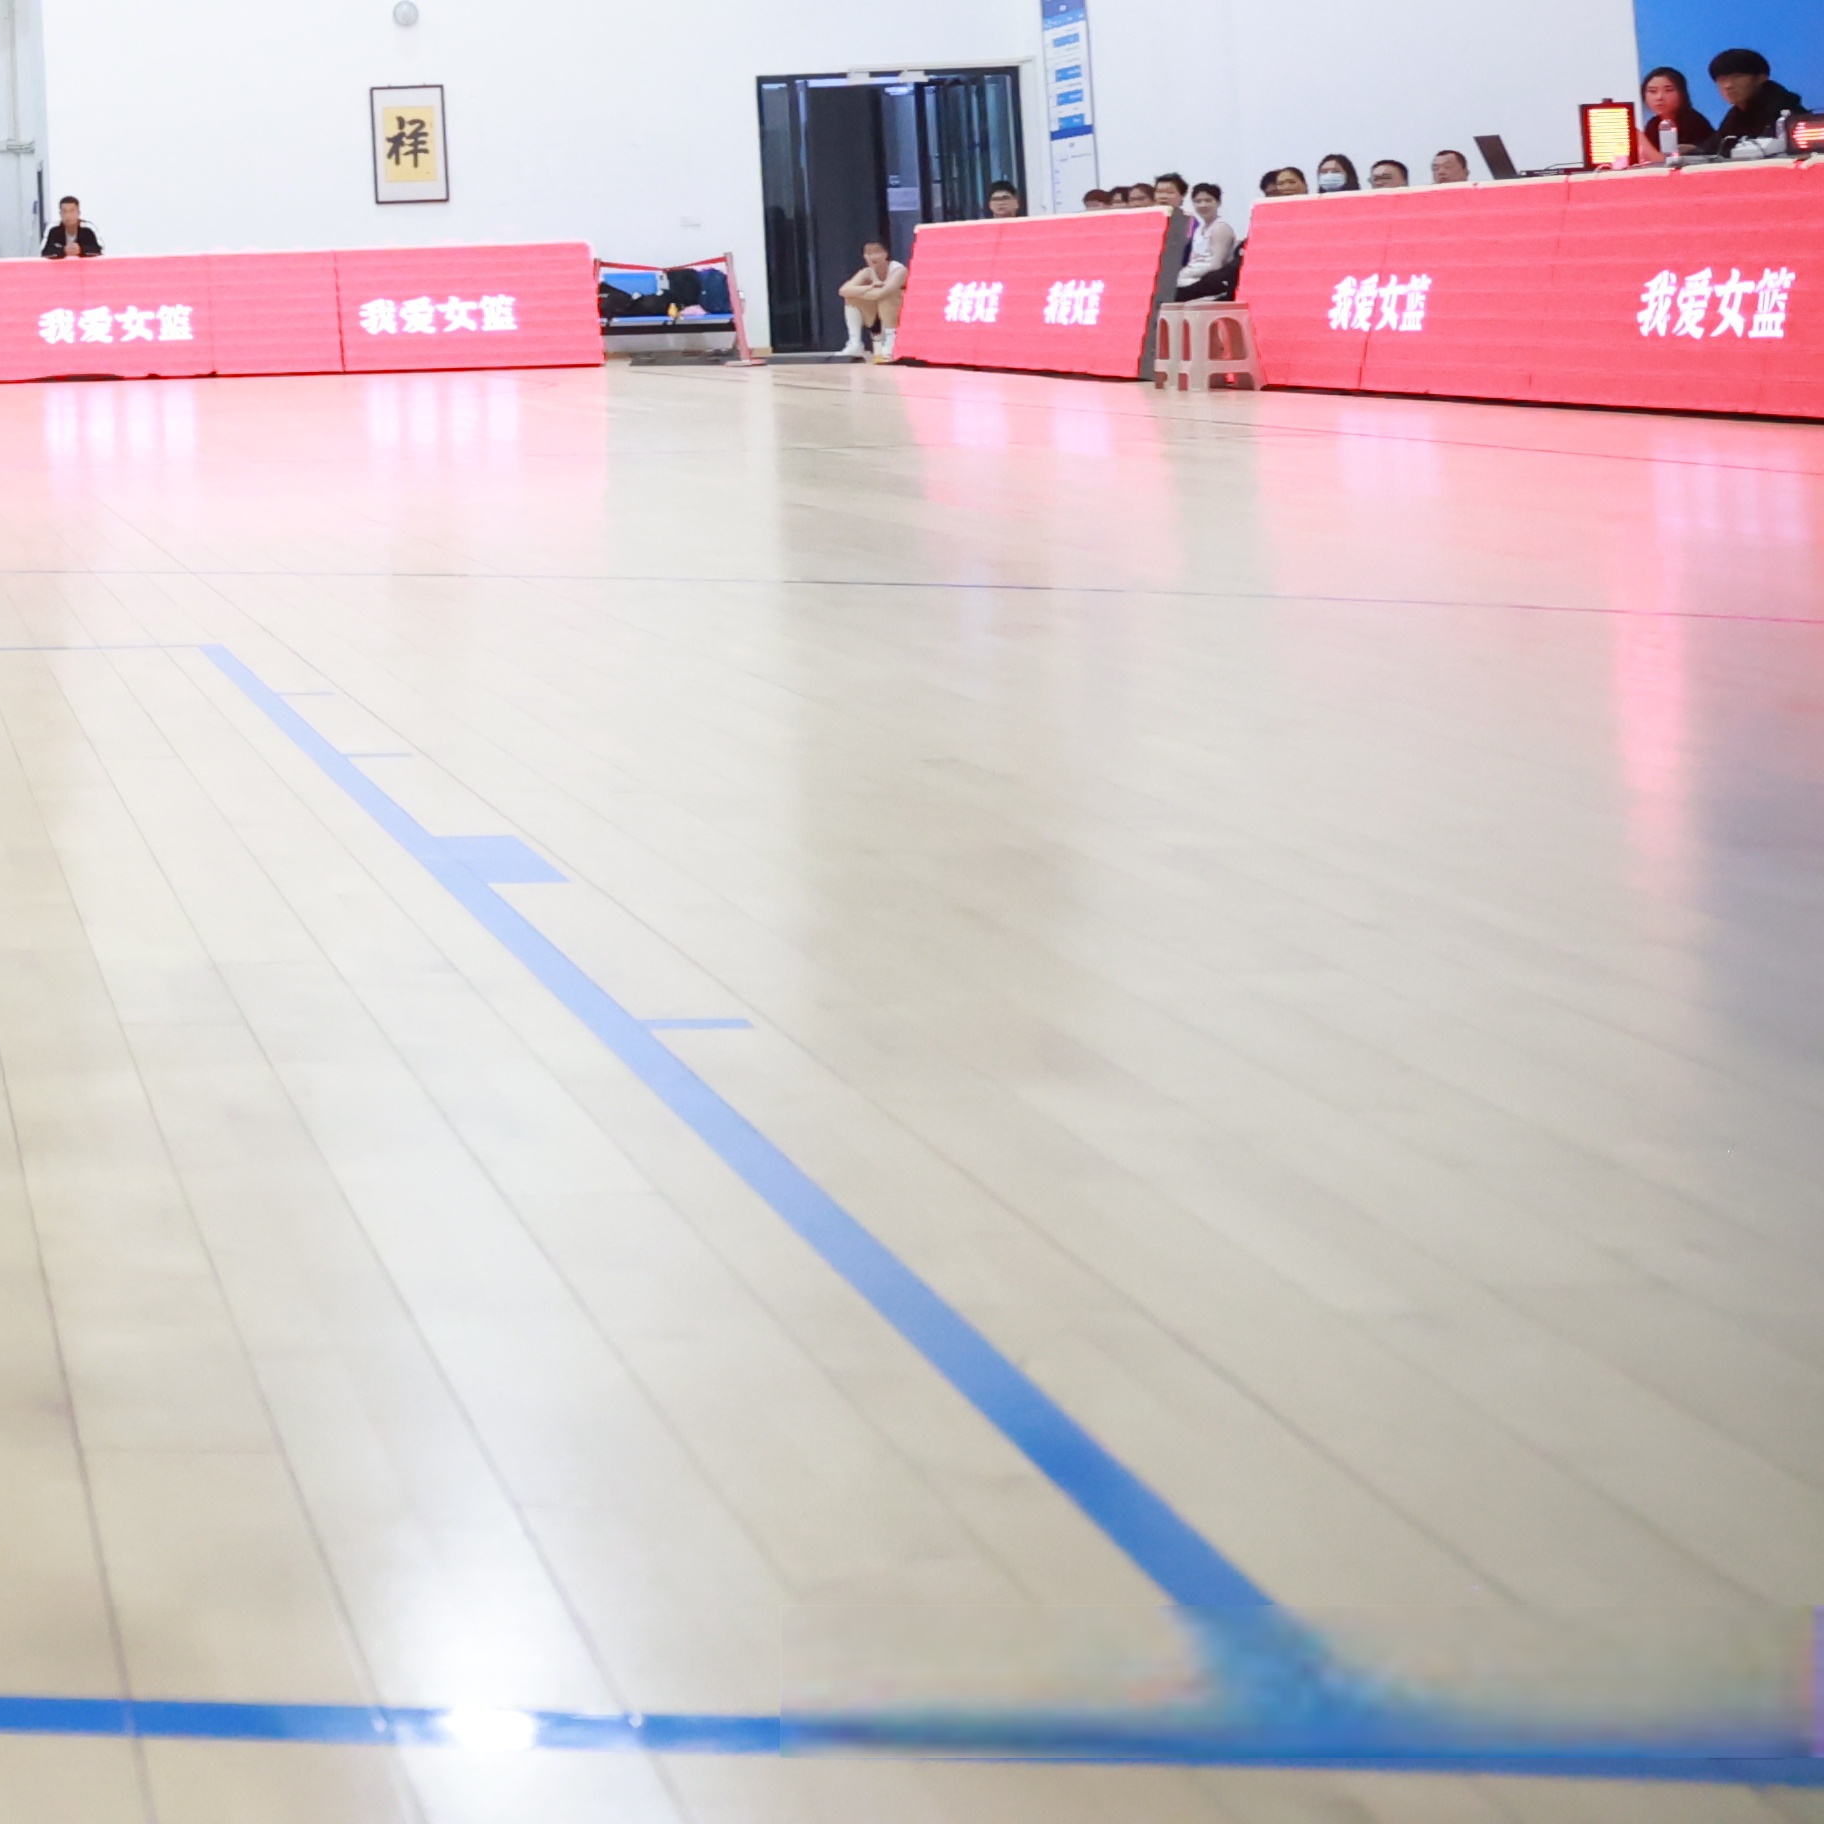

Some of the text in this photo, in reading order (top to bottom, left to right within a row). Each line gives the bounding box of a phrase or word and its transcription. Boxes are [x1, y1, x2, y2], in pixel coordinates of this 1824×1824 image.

[386, 116, 430, 169] 祥
[38, 304, 194, 345] 我爱女篮
[359, 294, 518, 335] 我爱女篮
[943, 279, 1104, 326] 我爱女篮 我爱女篮
[1327, 274, 1433, 332] 我爱女篮
[1636, 267, 1796, 340] 我爱女篮
